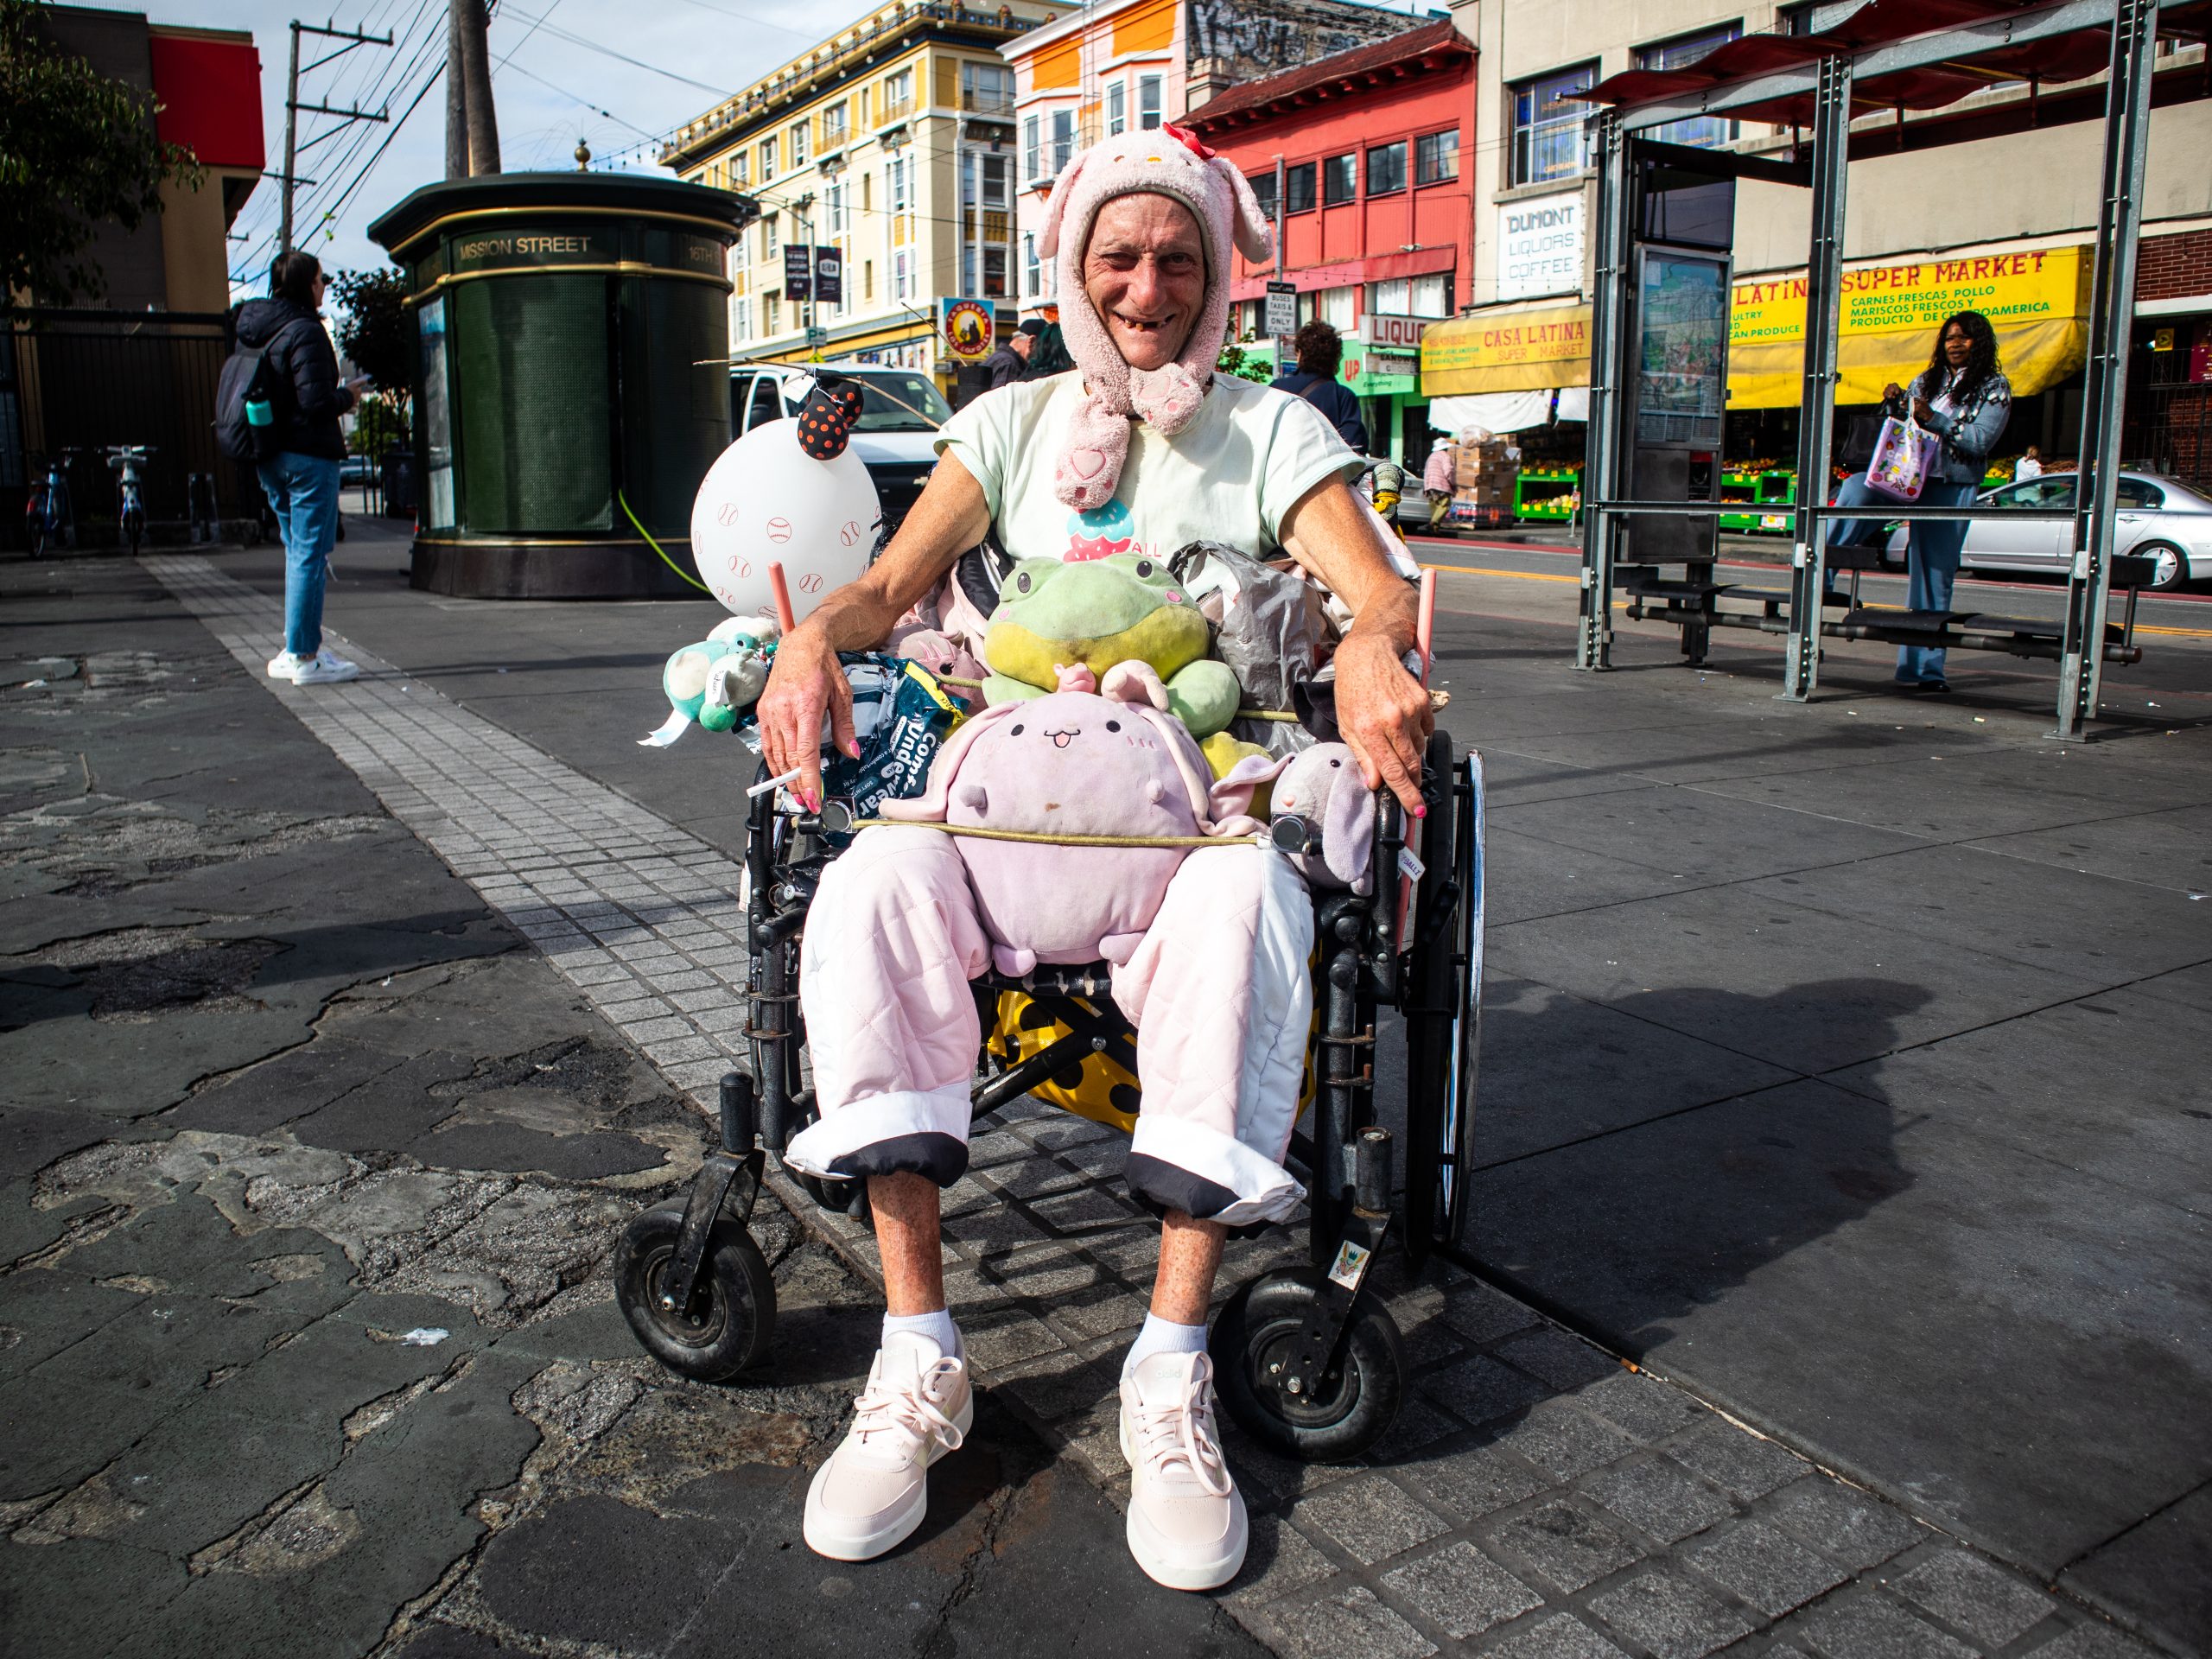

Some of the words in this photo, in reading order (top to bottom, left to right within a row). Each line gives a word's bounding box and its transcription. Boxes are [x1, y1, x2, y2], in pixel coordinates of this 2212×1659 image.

[1507, 206, 1574, 234] DUMONT
[460, 238, 512, 261] MISSION
[516, 237, 591, 253] STREET
[1509, 232, 1574, 257] LIQUORS
[1509, 257, 1573, 278] COFFEE
[1841, 265, 1921, 293] SUPER
[1936, 251, 2047, 283] MARKET
[1852, 295, 1895, 307] CARNES
[1898, 290, 1947, 302] FRESCAS
[1955, 286, 1995, 298] POLLO
[1729, 311, 1762, 321] ULTRY
[1850, 303, 1910, 317] MARISCOS
[1912, 299, 1964, 312] FRESCOS
[1967, 298, 1974, 308] Y
[1751, 324, 1801, 337] PRODUCE
[1850, 314, 1914, 327] PRODUCTO
[1923, 313, 1938, 322] DE
[808, 328, 817, 342] P
[1484, 327, 1522, 347] CASA
[1528, 321, 1585, 344] LATINA
[1497, 347, 1528, 361] SUPER
[1539, 343, 1584, 358] MARKET
[1344, 359, 1359, 381] UP
